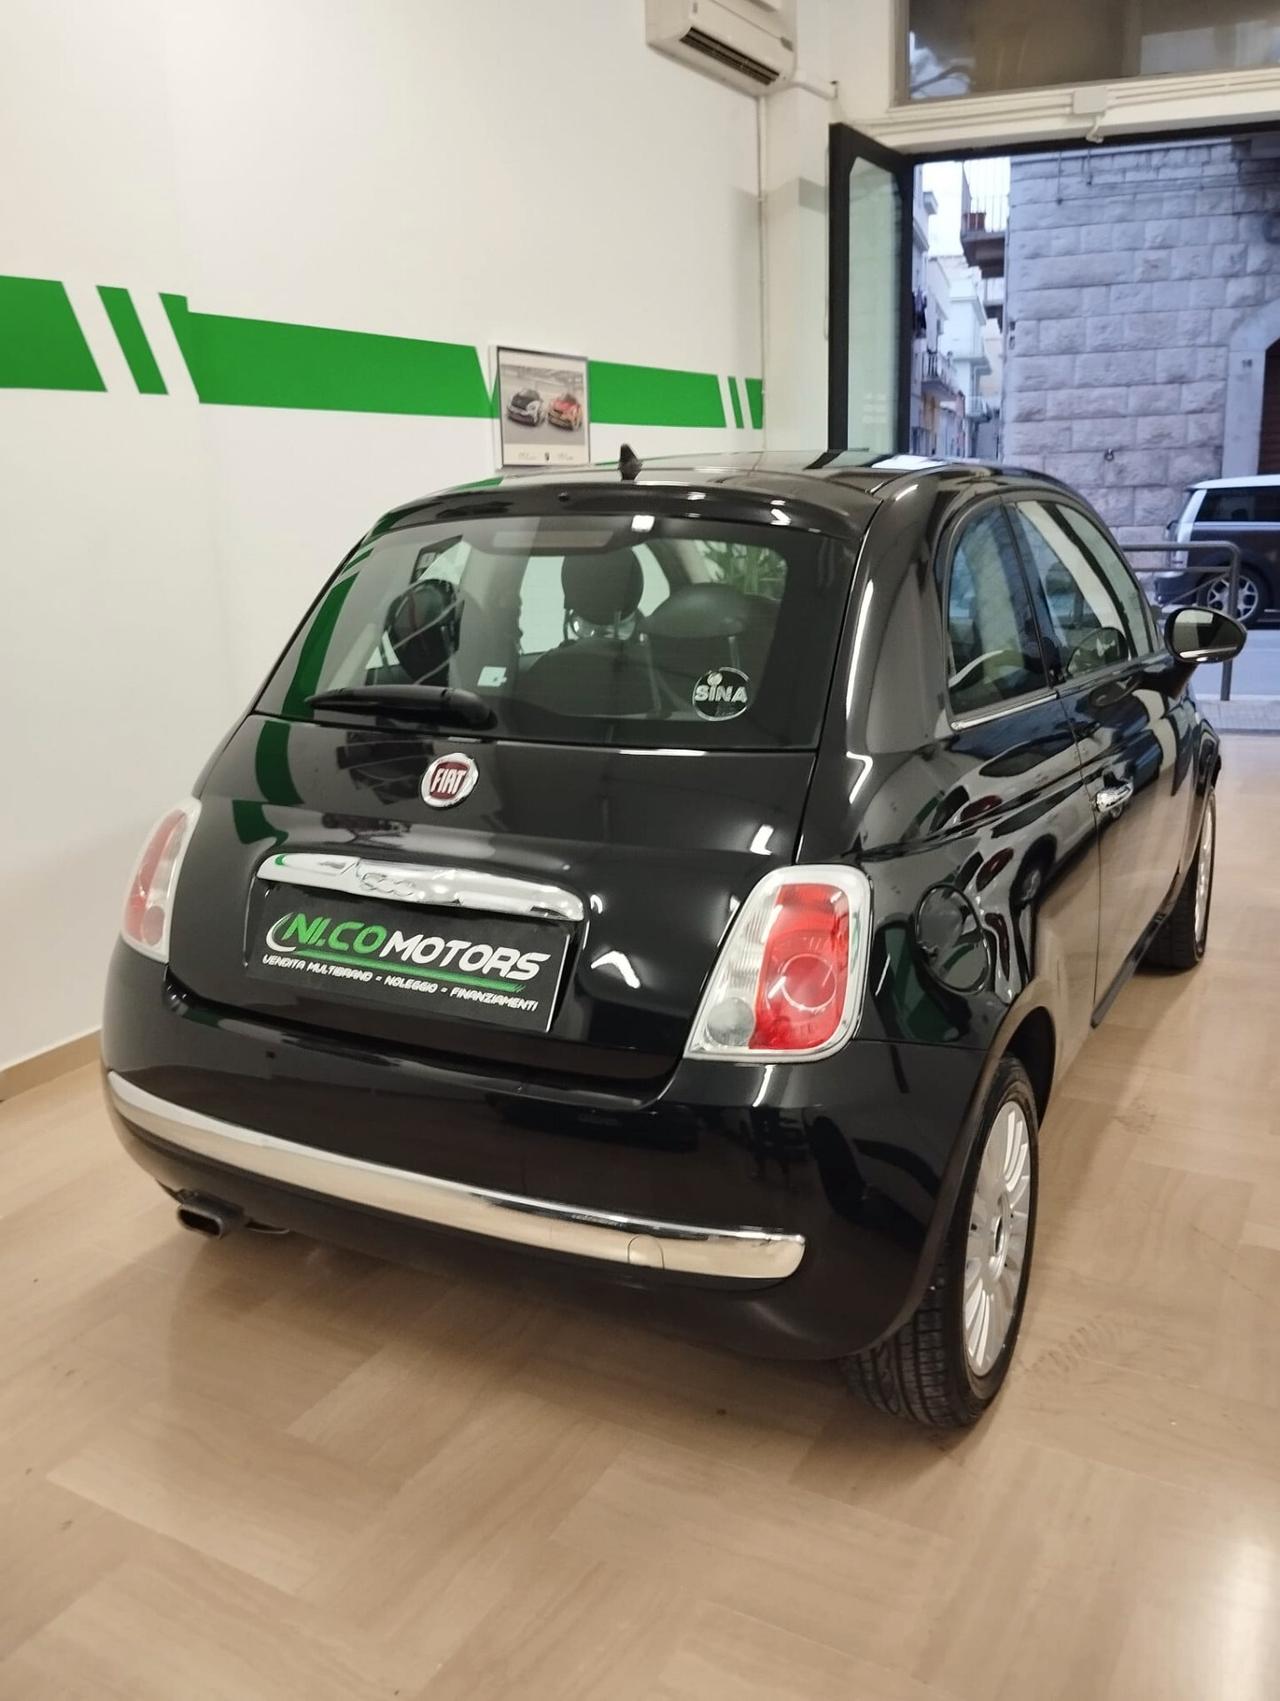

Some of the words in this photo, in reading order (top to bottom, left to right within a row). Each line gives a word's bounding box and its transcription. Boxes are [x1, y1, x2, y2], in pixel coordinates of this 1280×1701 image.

[431, 768, 467, 795] FIAT
[262, 954, 306, 970] VENDITA
[306, 962, 373, 982] MULTIBRAND
[384, 974, 438, 994] NOLEGGIO
[450, 986, 538, 1012] FINANZIAMENTI
